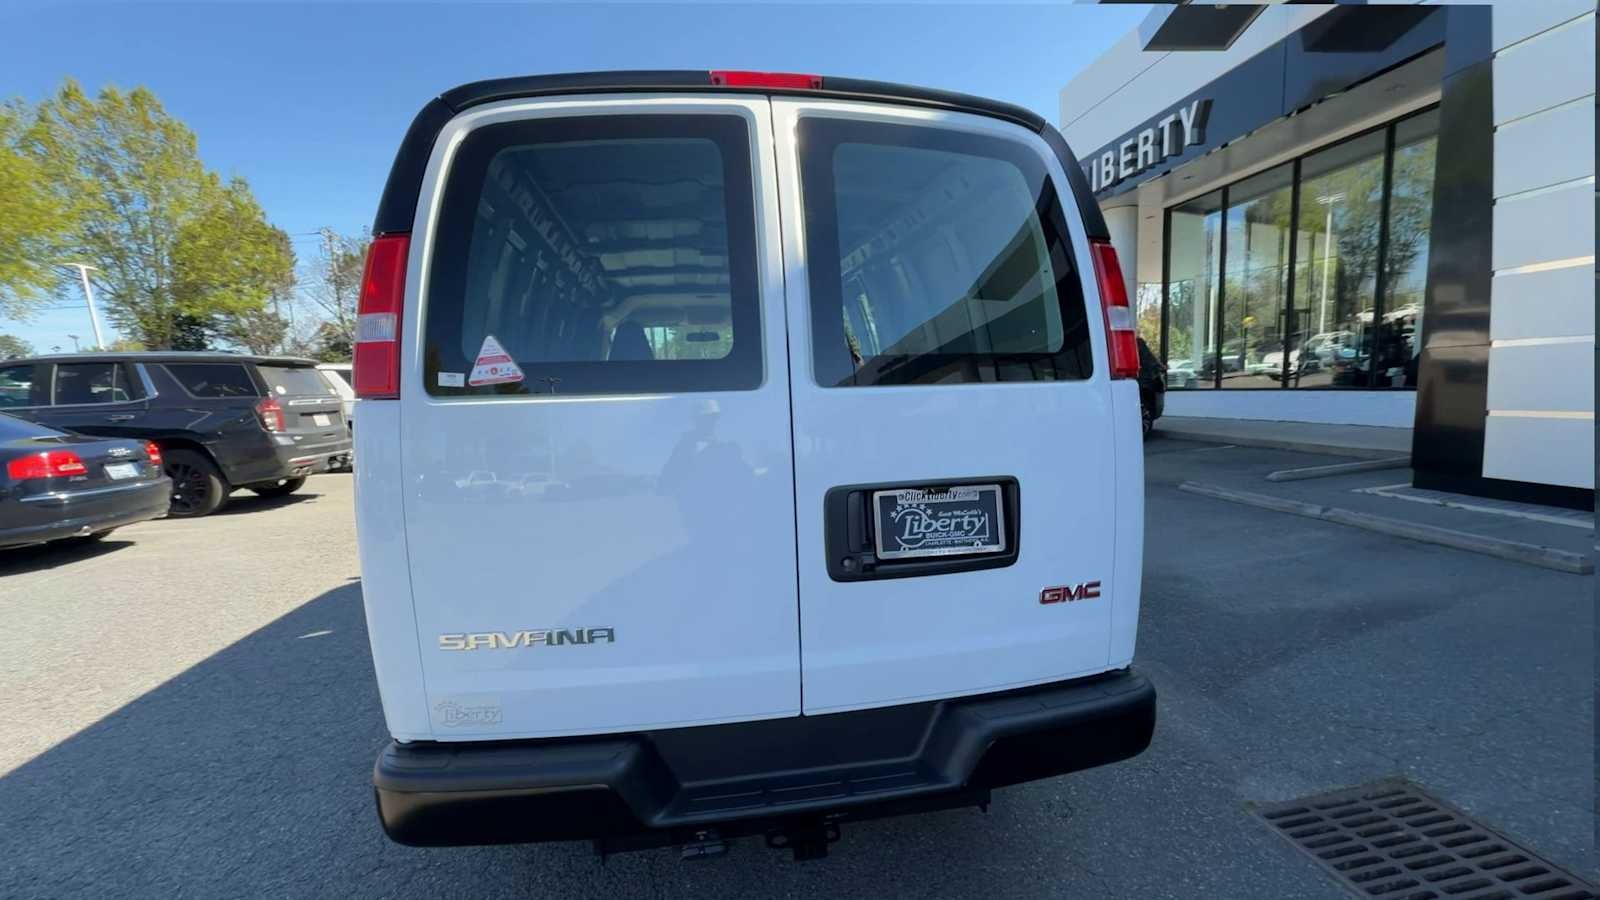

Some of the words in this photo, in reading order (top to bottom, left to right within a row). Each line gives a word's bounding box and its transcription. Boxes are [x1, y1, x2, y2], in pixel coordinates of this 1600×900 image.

[1084, 99, 1211, 193] IBERTY
[901, 513, 985, 539] Liberty
[1040, 580, 1101, 605] GMC
[438, 626, 616, 651] SAVANA
